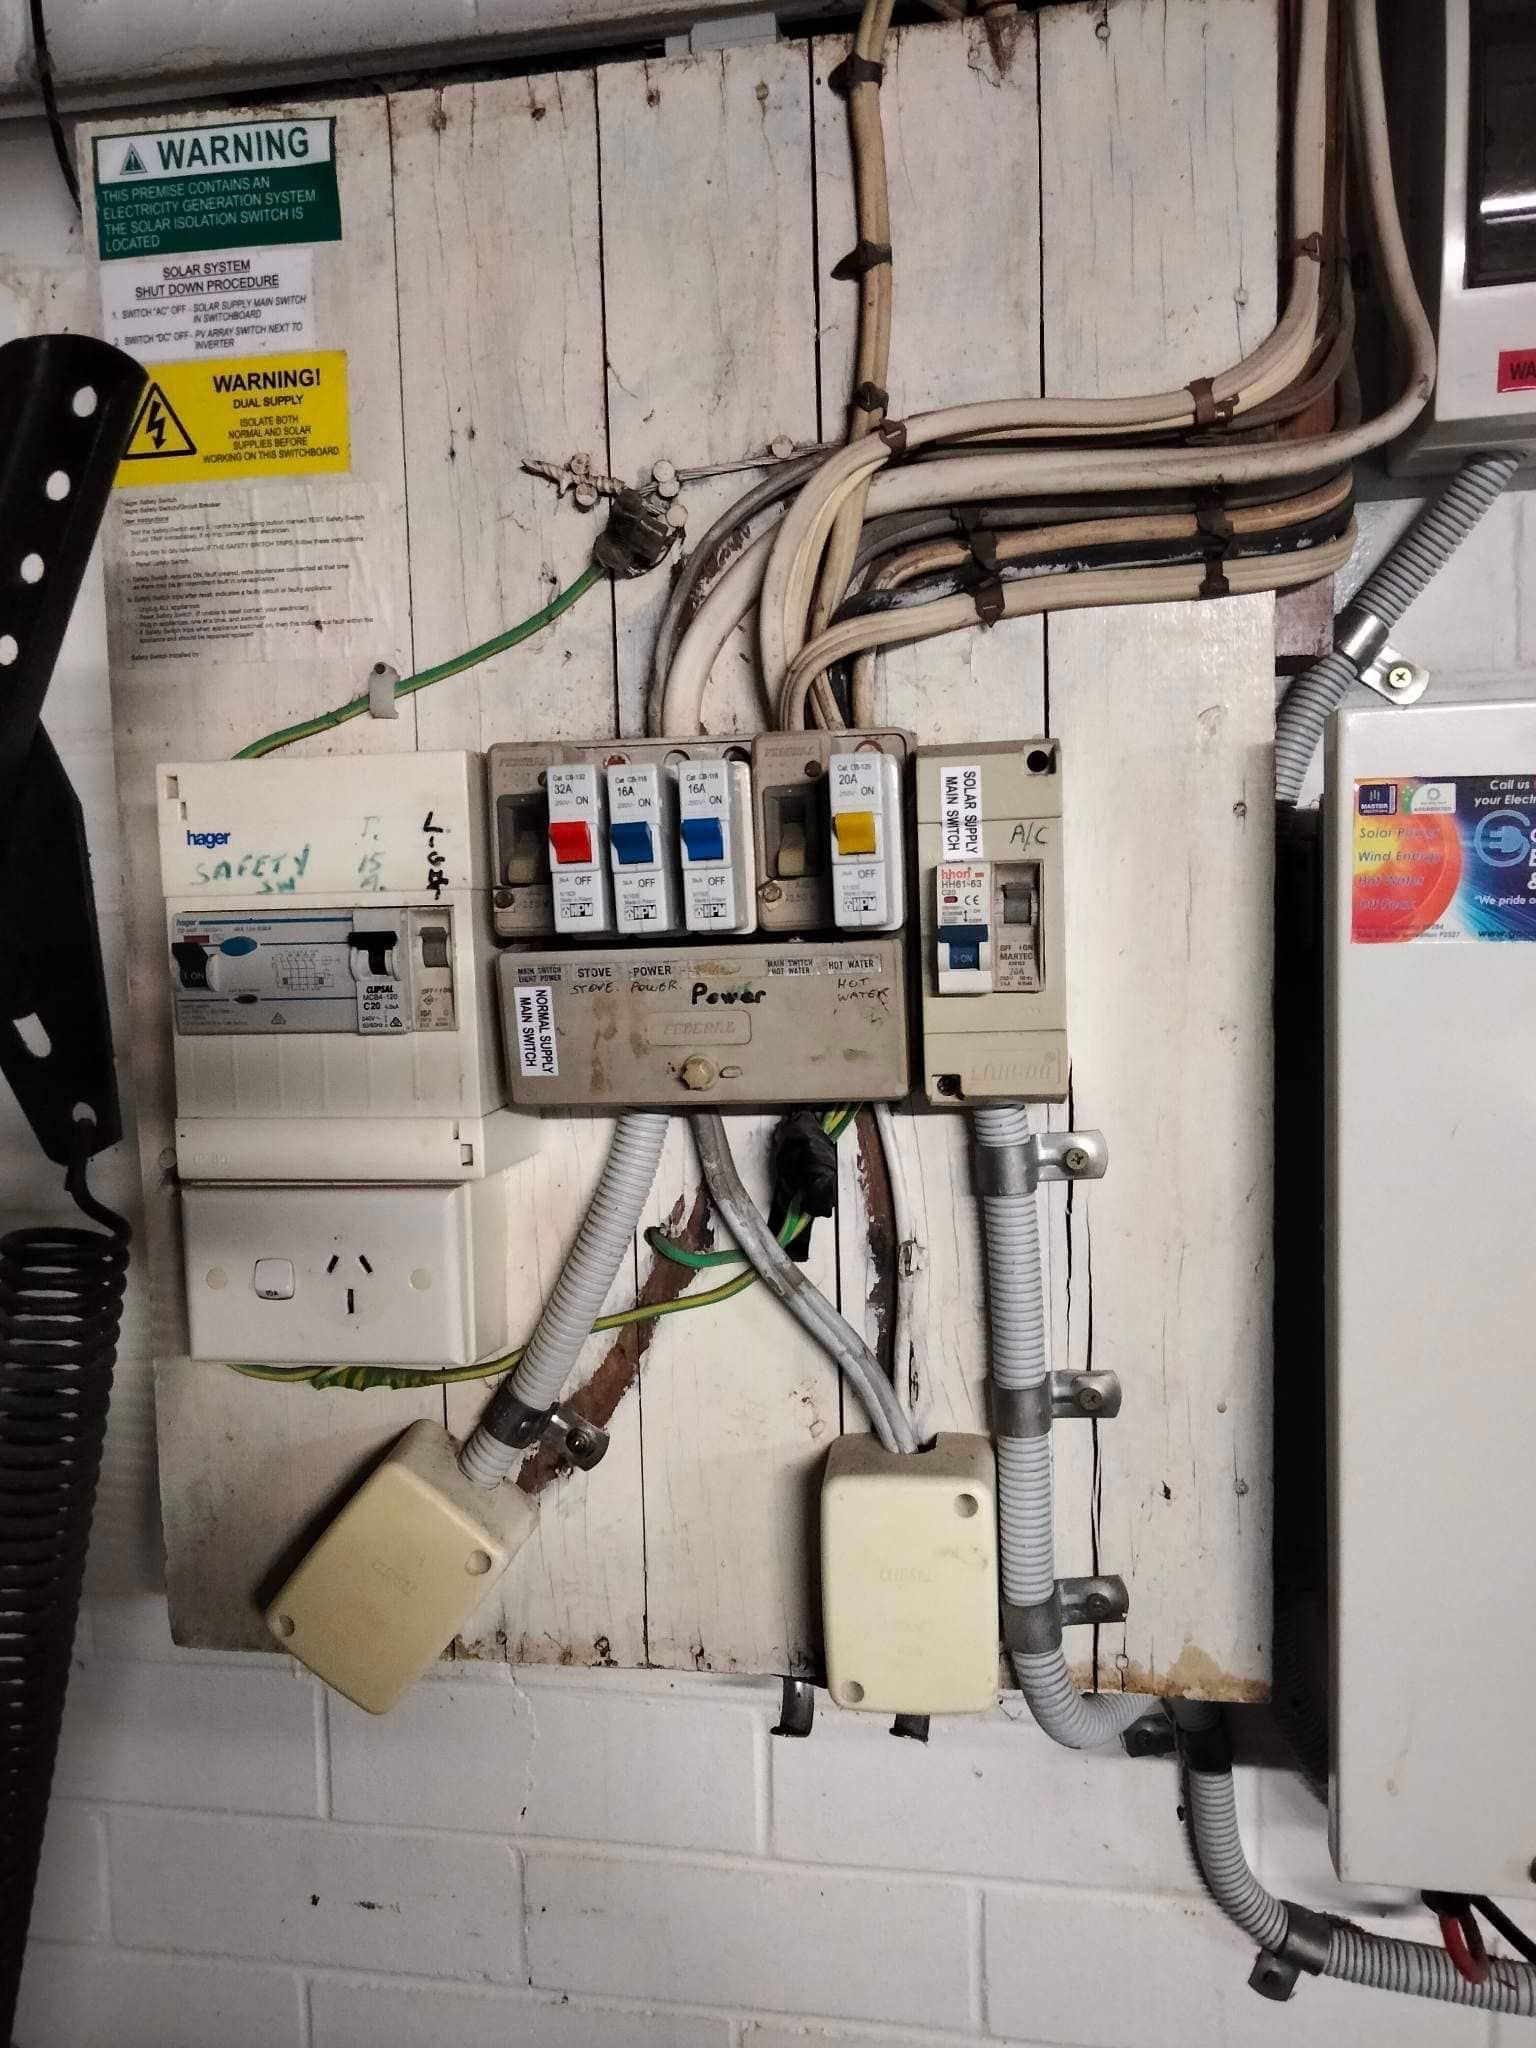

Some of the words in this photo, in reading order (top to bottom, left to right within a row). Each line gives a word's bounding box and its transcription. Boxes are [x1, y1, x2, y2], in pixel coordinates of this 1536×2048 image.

[157, 126, 309, 170] WARNING
[102, 190, 129, 202] THIS
[132, 183, 185, 200] PREMISE
[188, 178, 251, 195] CONTAINS
[253, 176, 270, 189] AN
[103, 201, 178, 220] ELECTRICITY
[183, 194, 262, 212] GENERATION
[265, 189, 316, 204] SYSTEM
[105, 222, 127, 235] THE
[130, 218, 171, 234] SOLAR
[174, 212, 237, 229] ISOLATION
[240, 208, 288, 224] SWITCH
[292, 206, 304, 220] IS
[105, 235, 160, 252] LOCATED
[163, 264, 200, 279] SOLAR
[204, 259, 251, 274] SYSTEM
[135, 285, 164, 299] SHUT
[169, 282, 204, 296] DOWN
[207, 274, 279, 291] PROCEDURE
[121, 309, 152, 320] SWITCH
[171, 305, 186, 314] OFF
[193, 302, 220, 313] SOLAR
[221, 300, 251, 311] SUPPLY
[253, 298, 273, 308] MAIN
[275, 295, 306, 306] SWITCH
[193, 315, 203, 324] IN
[203, 310, 262, 322] SWITCHBOARD
[124, 334, 155, 346] SWITCH
[174, 331, 189, 340] OFF
[194, 329, 207, 339] PV
[207, 327, 234, 338] ARRAY
[235, 324, 267, 335] SWITCH
[268, 322, 289, 333] NEXT
[292, 322, 303, 331] TO
[194, 338, 235, 350] INVERTER
[213, 368, 321, 393] WARNING!
[233, 398, 261, 409] DUAL
[263, 395, 304, 407] SUPPLY
[240, 416, 274, 428] ISOLATE
[275, 415, 298, 425] BOTH
[228, 429, 263, 439] NORMAL
[265, 428, 281, 437] AND
[284, 425, 312, 436] SOLAR
[233, 439, 273, 450] SUPPLIES
[274, 436, 307, 447] BEFORE
[203, 453, 242, 463] WORKING
[243, 452, 257, 460] ON
[259, 450, 277, 459] THIS
[278, 446, 340, 458] SWITCHBOARD
[839, 774, 858, 785] 20A
[1490, 780, 1514, 790] Call
[1517, 781, 1530, 790] us
[554, 784, 573, 795] 32A
[617, 786, 635, 797] 16A
[688, 783, 706, 794] 16A
[860, 786, 874, 796] ON
[945, 776, 959, 805] MAIN
[963, 771, 977, 810] SOLAR
[575, 796, 589, 805] ON
[638, 798, 651, 807] ON
[709, 795, 722, 805] ON
[1474, 796, 1502, 807] your
[946, 810, 960, 851] SWITCH
[964, 814, 978, 854] SUPPLY
[1009, 822, 1049, 852] A/C
[1359, 827, 1393, 839] Solar
[186, 830, 231, 848] hager
[1358, 850, 1391, 862] Wind
[190, 844, 311, 885] SAFETY
[858, 869, 877, 879] OFF
[574, 876, 592, 886] OFF
[638, 878, 656, 888] OFF
[708, 876, 726, 886] OFF
[941, 880, 982, 889] HH61-63
[1498, 895, 1526, 907] pride
[767, 959, 785, 967] MAIN
[787, 958, 813, 967] SWITCH
[999, 952, 1033, 961] MARTEC
[633, 965, 672, 977] POWER
[771, 967, 784, 975] HOT
[789, 966, 810, 975] WATER
[828, 960, 844, 970] HOT
[847, 959, 874, 969] WATER
[577, 967, 612, 978] STOVE
[366, 985, 395, 994] CLIPSAL
[837, 977, 870, 989] HOT
[691, 982, 767, 1006] Power
[519, 997, 533, 1023] MAIN
[535, 989, 551, 1034] NORMAL
[522, 1027, 537, 1067] SWITCH
[540, 1035, 554, 1074] SUPPLY
